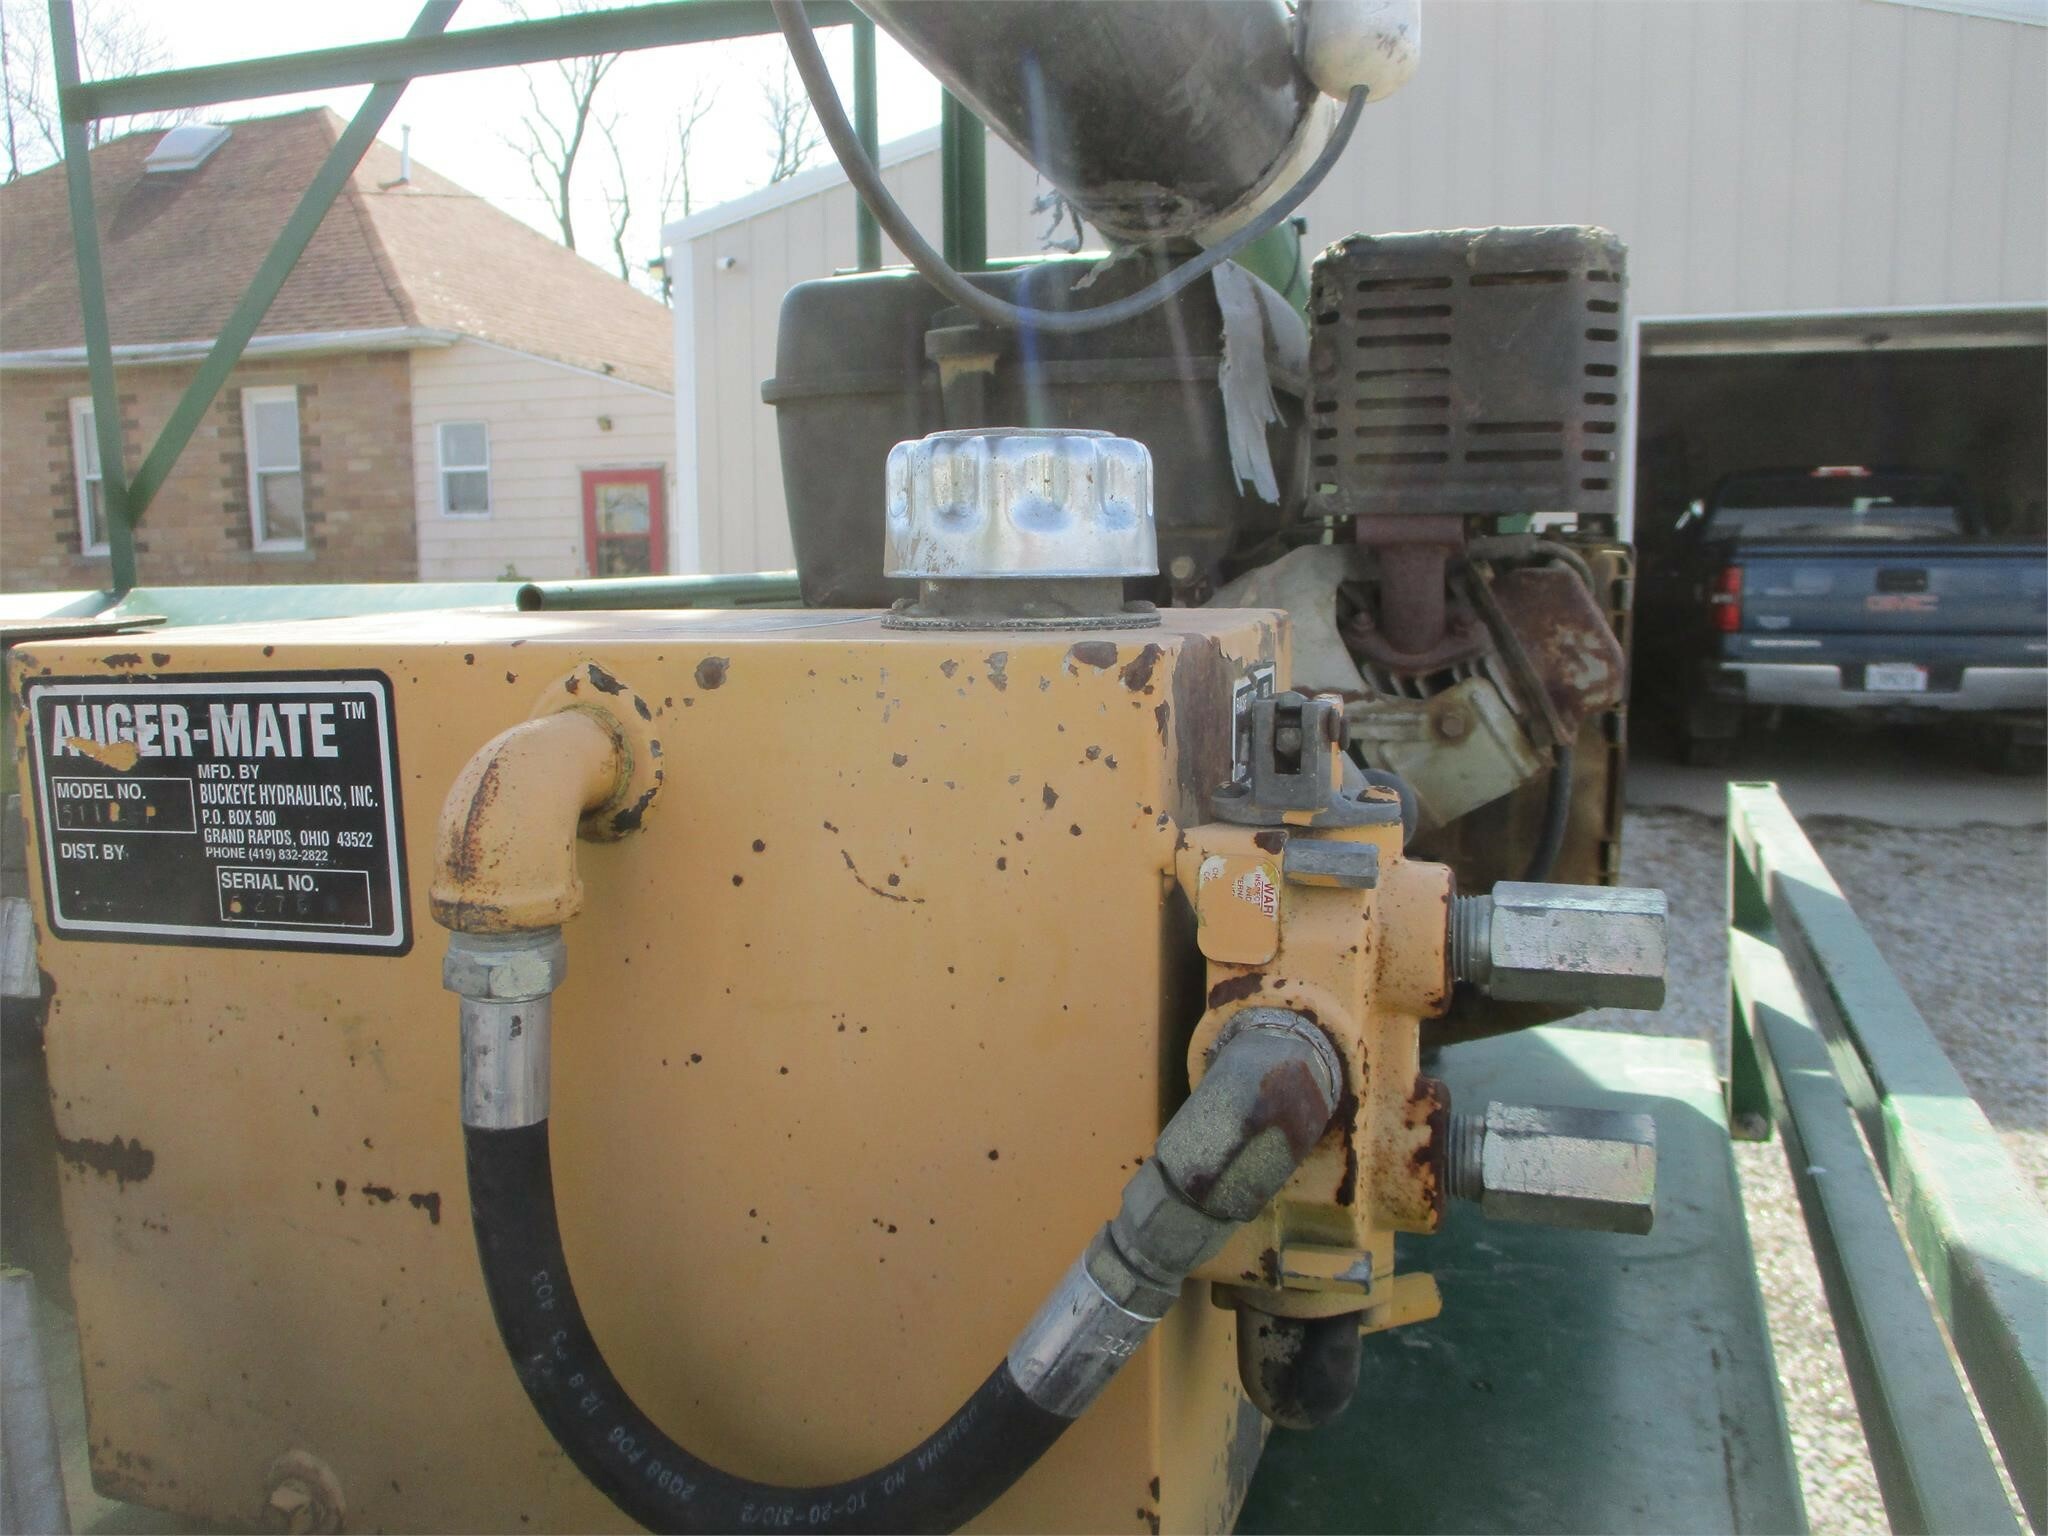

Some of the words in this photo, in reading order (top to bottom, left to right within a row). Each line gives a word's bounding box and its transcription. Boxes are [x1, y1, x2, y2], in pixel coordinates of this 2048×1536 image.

[198, 764, 235, 780] MFD.
[239, 765, 259, 780] BY
[57, 783, 114, 799] MODEL
[118, 783, 146, 800] NO.
[200, 784, 256, 806] BUCKEYE
[260, 785, 347, 809] HYDRAULICS,
[351, 787, 378, 808] INC.
[203, 810, 226, 825] P.O.
[229, 810, 252, 825] BOX
[255, 811, 276, 825] 500
[204, 829, 245, 844] GRAND
[249, 830, 296, 847] RAPIDS,
[300, 831, 330, 846] OHIO
[337, 832, 373, 848] 43522
[62, 843, 98, 859] DIST.
[102, 844, 125, 860] BY
[206, 847, 245, 859] PHONE
[249, 848, 276, 862] (419)
[279, 849, 328, 861] 832-2822
[221, 872, 284, 891] SERIAL
[288, 874, 319, 893] NO.
